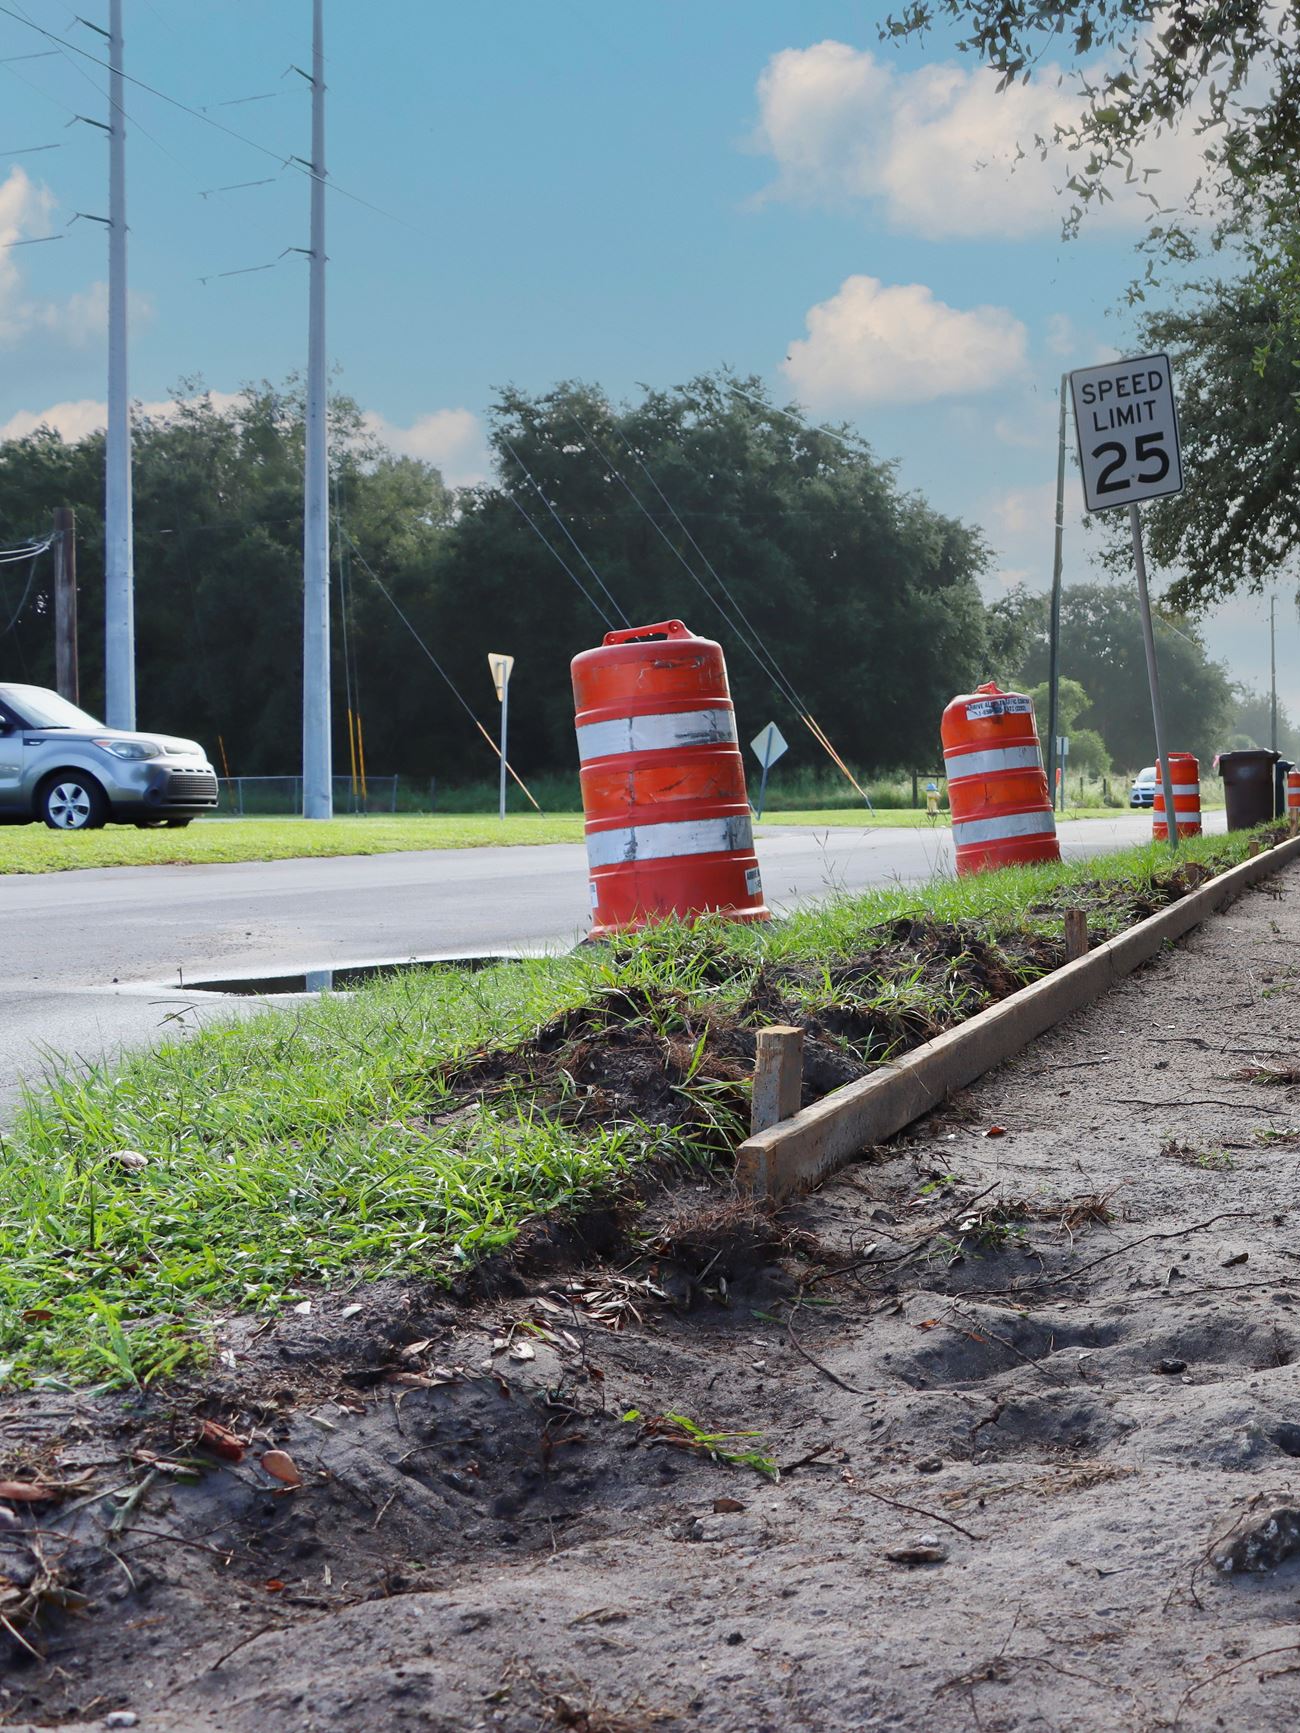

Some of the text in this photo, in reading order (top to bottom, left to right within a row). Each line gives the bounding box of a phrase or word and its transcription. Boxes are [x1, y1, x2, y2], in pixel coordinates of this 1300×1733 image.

[1082, 371, 1163, 404] SPEED
[1093, 400, 1156, 432] LIMIT
[1091, 432, 1170, 495] 25
